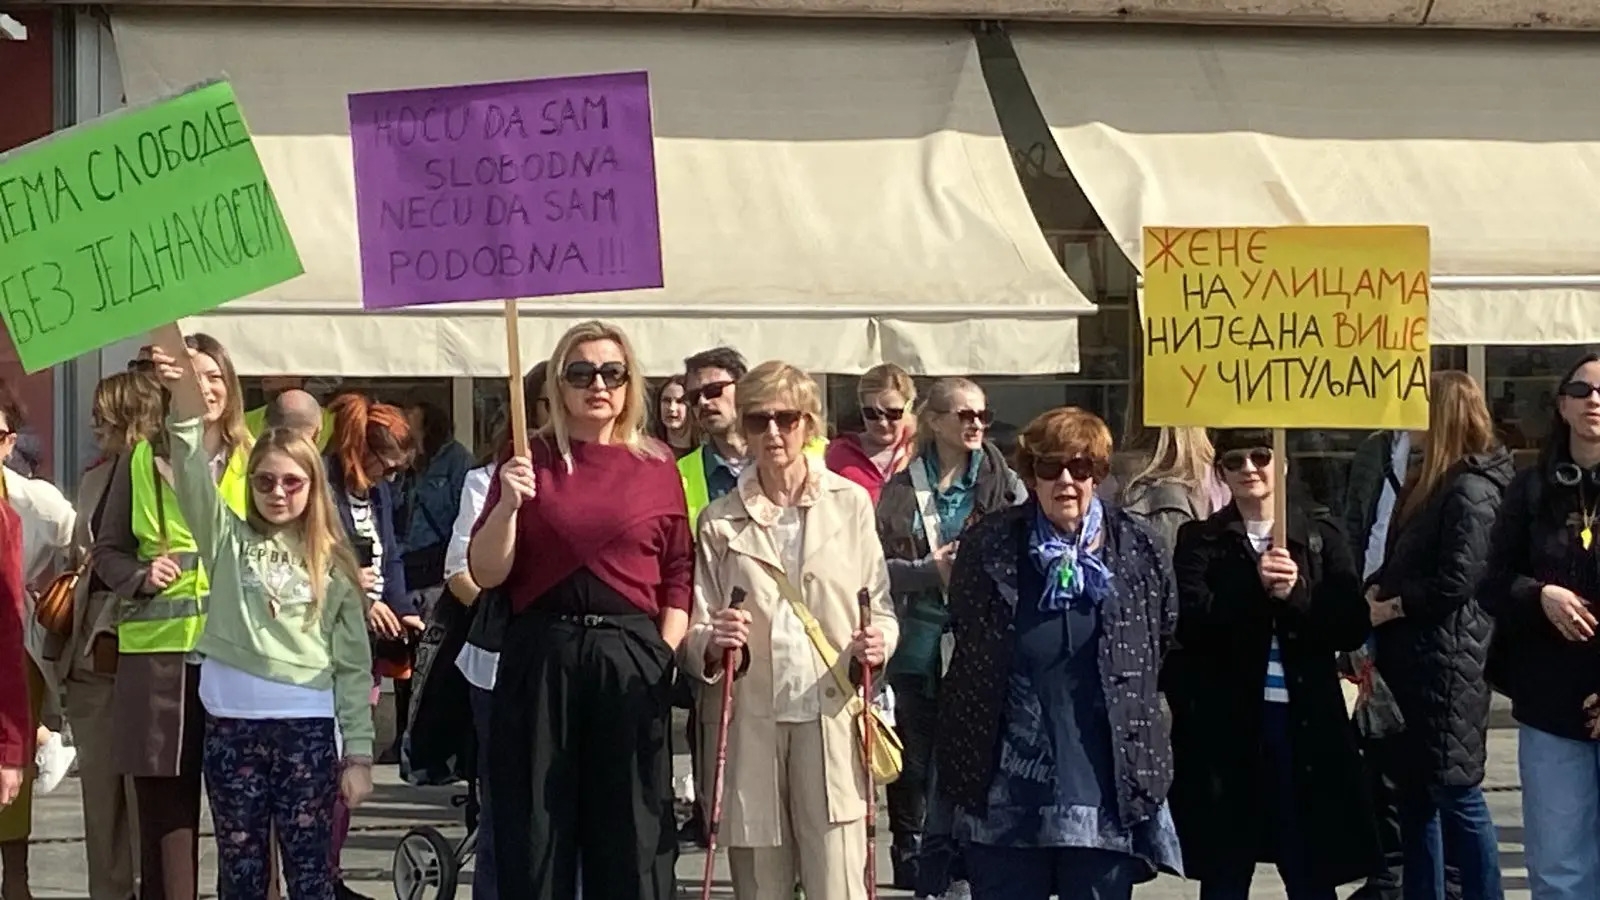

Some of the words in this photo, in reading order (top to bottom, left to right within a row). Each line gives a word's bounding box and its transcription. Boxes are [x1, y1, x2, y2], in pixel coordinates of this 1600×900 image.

[484, 104, 527, 139] DA
[540, 95, 608, 134] SAM
[88, 102, 250, 201] СЛОБОДЕ
[424, 145, 621, 190] SLOBODNA
[485, 194, 531, 226] DA
[545, 187, 617, 223] SAM
[1, 262, 75, 345] БЕЗ
[76, 180, 286, 312] ЈЕДНАКОСТИ
[389, 242, 589, 285] PODOBNA
[1145, 229, 1268, 273] ЖЕНЕ
[1183, 272, 1236, 310] НА
[1240, 266, 1430, 309] УЛИЦАМА
[1147, 312, 1325, 356] НИЈЕДНА
[1332, 311, 1428, 351] ВИШЕ
[1180, 364, 1208, 408] У
[1217, 355, 1430, 404] ЧИТУЉАМА
